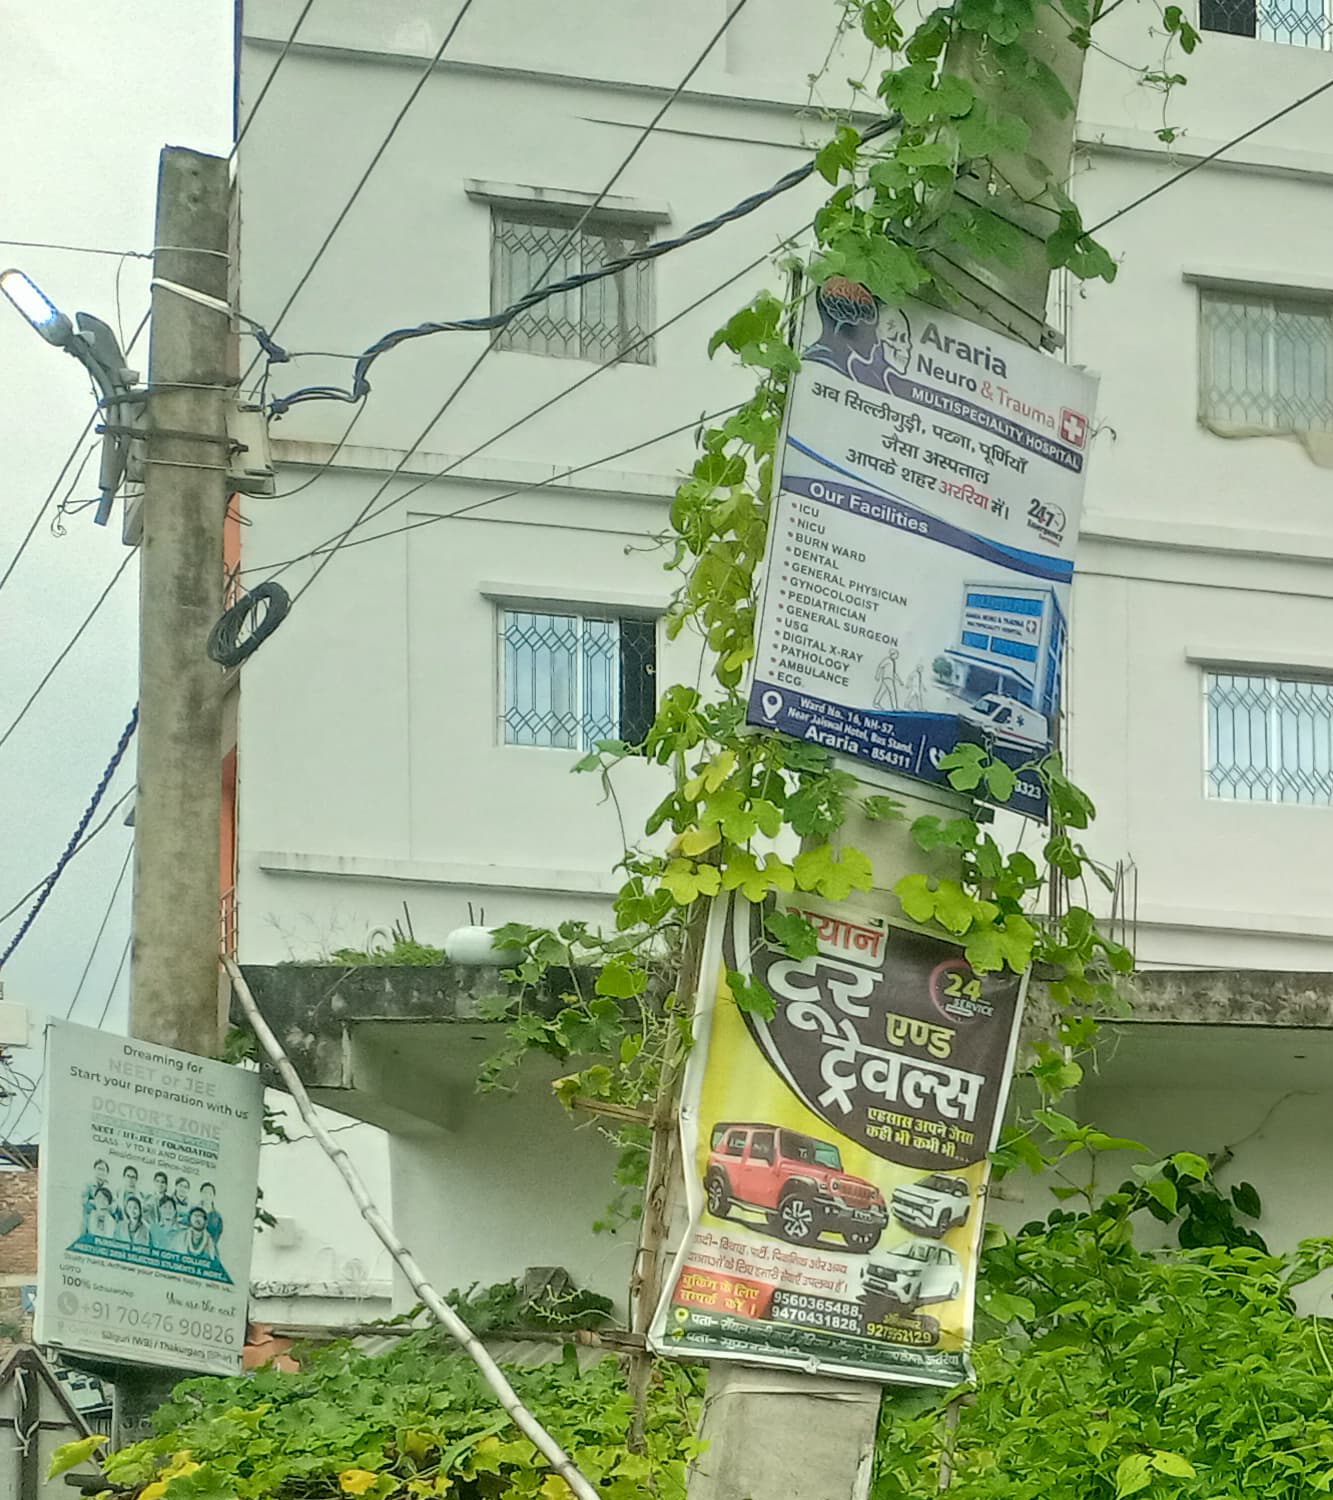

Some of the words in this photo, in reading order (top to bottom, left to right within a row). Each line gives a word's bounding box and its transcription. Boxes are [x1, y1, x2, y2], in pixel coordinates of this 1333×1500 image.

[920, 322, 1007, 379] Araria
[917, 354, 977, 392] Neuro
[981, 381, 994, 401] &
[997, 386, 1055, 429] Trauma
[912, 387, 1023, 442] MULTISPECIALITY
[1026, 436, 1081, 471] HOSPITAL
[881, 433, 918, 459] जैसा
[923, 452, 989, 485] अस्पताल
[846, 448, 897, 475] आपके
[901, 468, 936, 490] शहर
[939, 480, 989, 510] अररिया
[799, 503, 819, 518] ICU
[809, 482, 845, 505] Our
[849, 494, 929, 533] Facilities
[797, 518, 825, 535] NICU
[793, 547, 840, 570] DENTAL
[795, 532, 829, 551] BURN
[832, 543, 866, 562] WARD
[790, 577, 880, 612] GYNOCOLOGIST
[791, 562, 846, 588] GENERAL
[849, 580, 907, 606] PHYSICIAN
[788, 590, 867, 623] PEDIATRICIAN
[784, 618, 809, 633] USG
[786, 605, 840, 630] GENERAL
[843, 622, 898, 647] SURGEON
[781, 644, 850, 673] PATHOLOGY
[782, 631, 827, 653] DIGITAL
[830, 645, 864, 663] X-RAY
[778, 659, 849, 687] AMBULANCE
[787, 706, 811, 723] Near
[799, 697, 826, 714] Ward
[804, 724, 859, 755] Araria
[870, 747, 911, 769] 854311
[787, 907, 884, 958] यान
[767, 955, 884, 1036] टूर
[944, 973, 982, 1000] 24
[886, 1012, 956, 1060] एण्ड
[108, 1058, 158, 1081] NEET
[185, 1077, 217, 1098] JEE
[123, 1045, 184, 1072] Dreaming
[186, 1061, 203, 1075] for
[818, 1018, 985, 1122] ट्रेवल्स
[70, 1065, 101, 1083] Start
[103, 1076, 131, 1090] your
[134, 1082, 204, 1109] preparation
[206, 1102, 232, 1117] with
[235, 1109, 249, 1120] us
[771, 1305, 861, 1335] 9470431828,
[773, 1291, 863, 1320] 9560365488,
[116, 1306, 174, 1333] 70476
[179, 1318, 235, 1345] 90826
